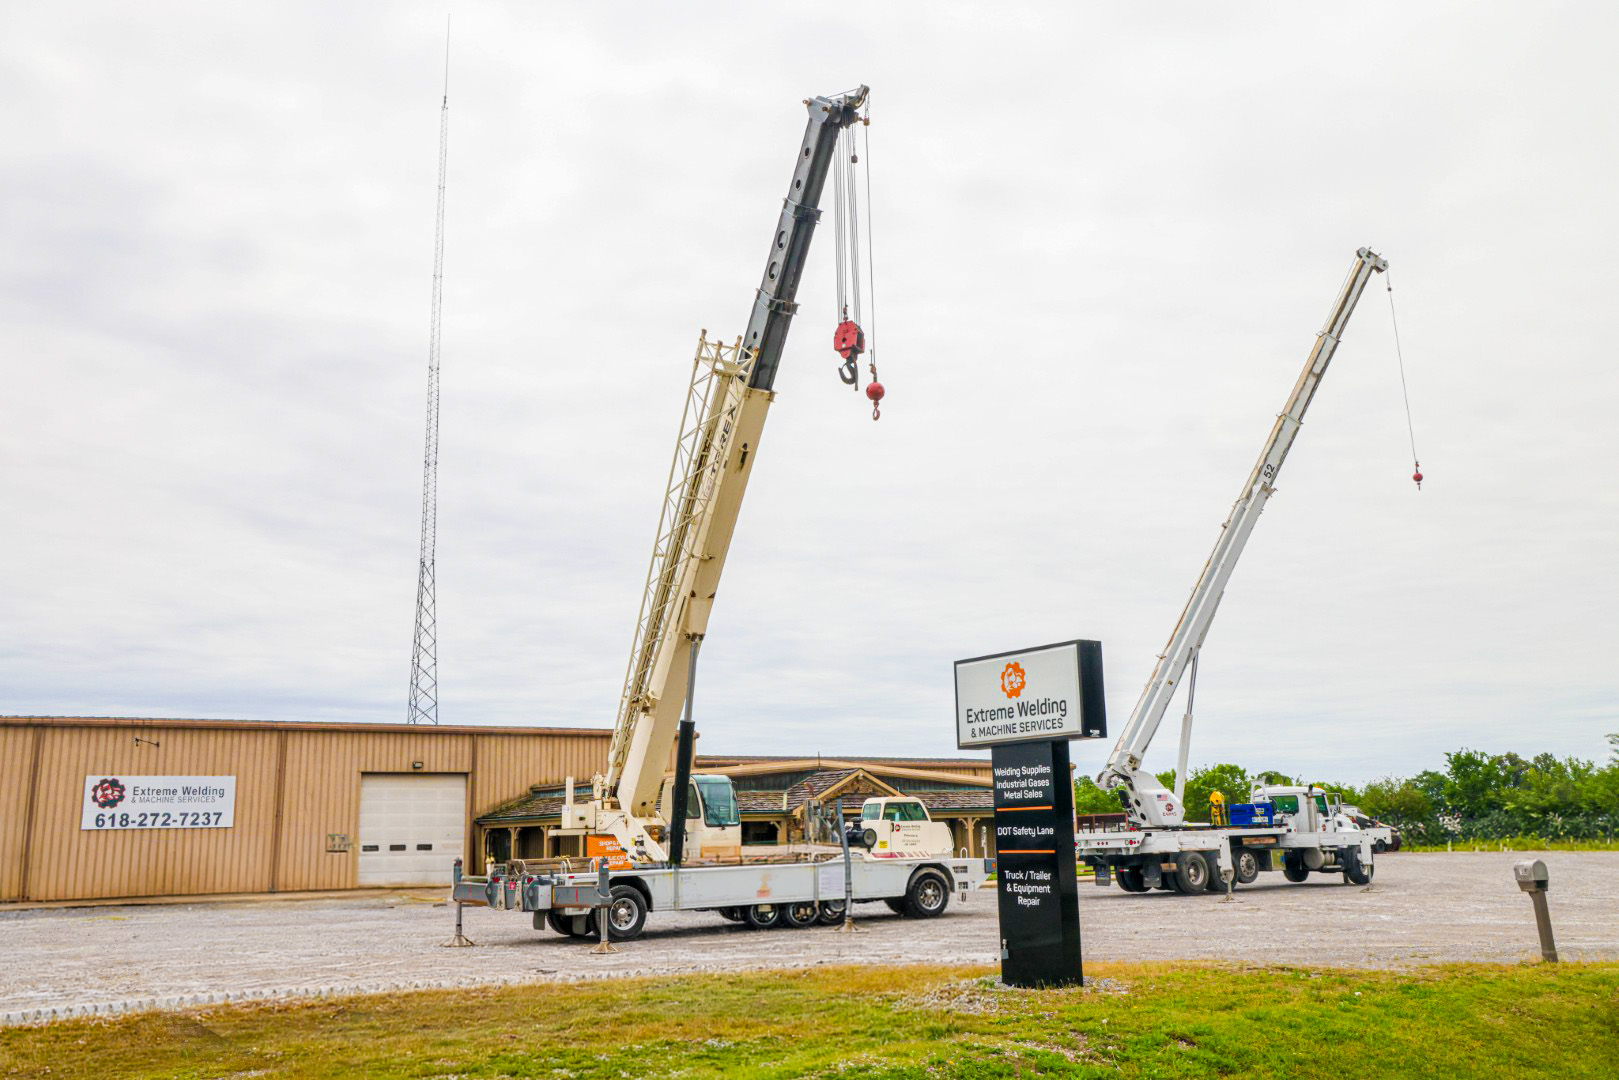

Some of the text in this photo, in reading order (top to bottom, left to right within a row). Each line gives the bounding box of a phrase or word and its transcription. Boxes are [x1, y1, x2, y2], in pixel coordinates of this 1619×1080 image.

[1263, 463, 1275, 479] 52
[966, 698, 1067, 724] Extreme Welding
[971, 718, 1064, 738] & MACHINE SERVICES
[994, 765, 1051, 778] Welding Supplies
[996, 778, 1050, 789] Industrial Gases
[132, 786, 225, 798] Extreme Welding
[1004, 789, 1043, 800] Metal Sales
[131, 796, 137, 804] &
[138, 796, 175, 804] MACHINE
[95, 812, 223, 828] 618-272-7237
[997, 826, 1054, 838] DOT Safety Lane
[1004, 870, 1024, 880] Truck
[1029, 870, 1051, 881] Trailer
[1006, 883, 1051, 895] & Equipment
[1017, 895, 1040, 908] Repair
